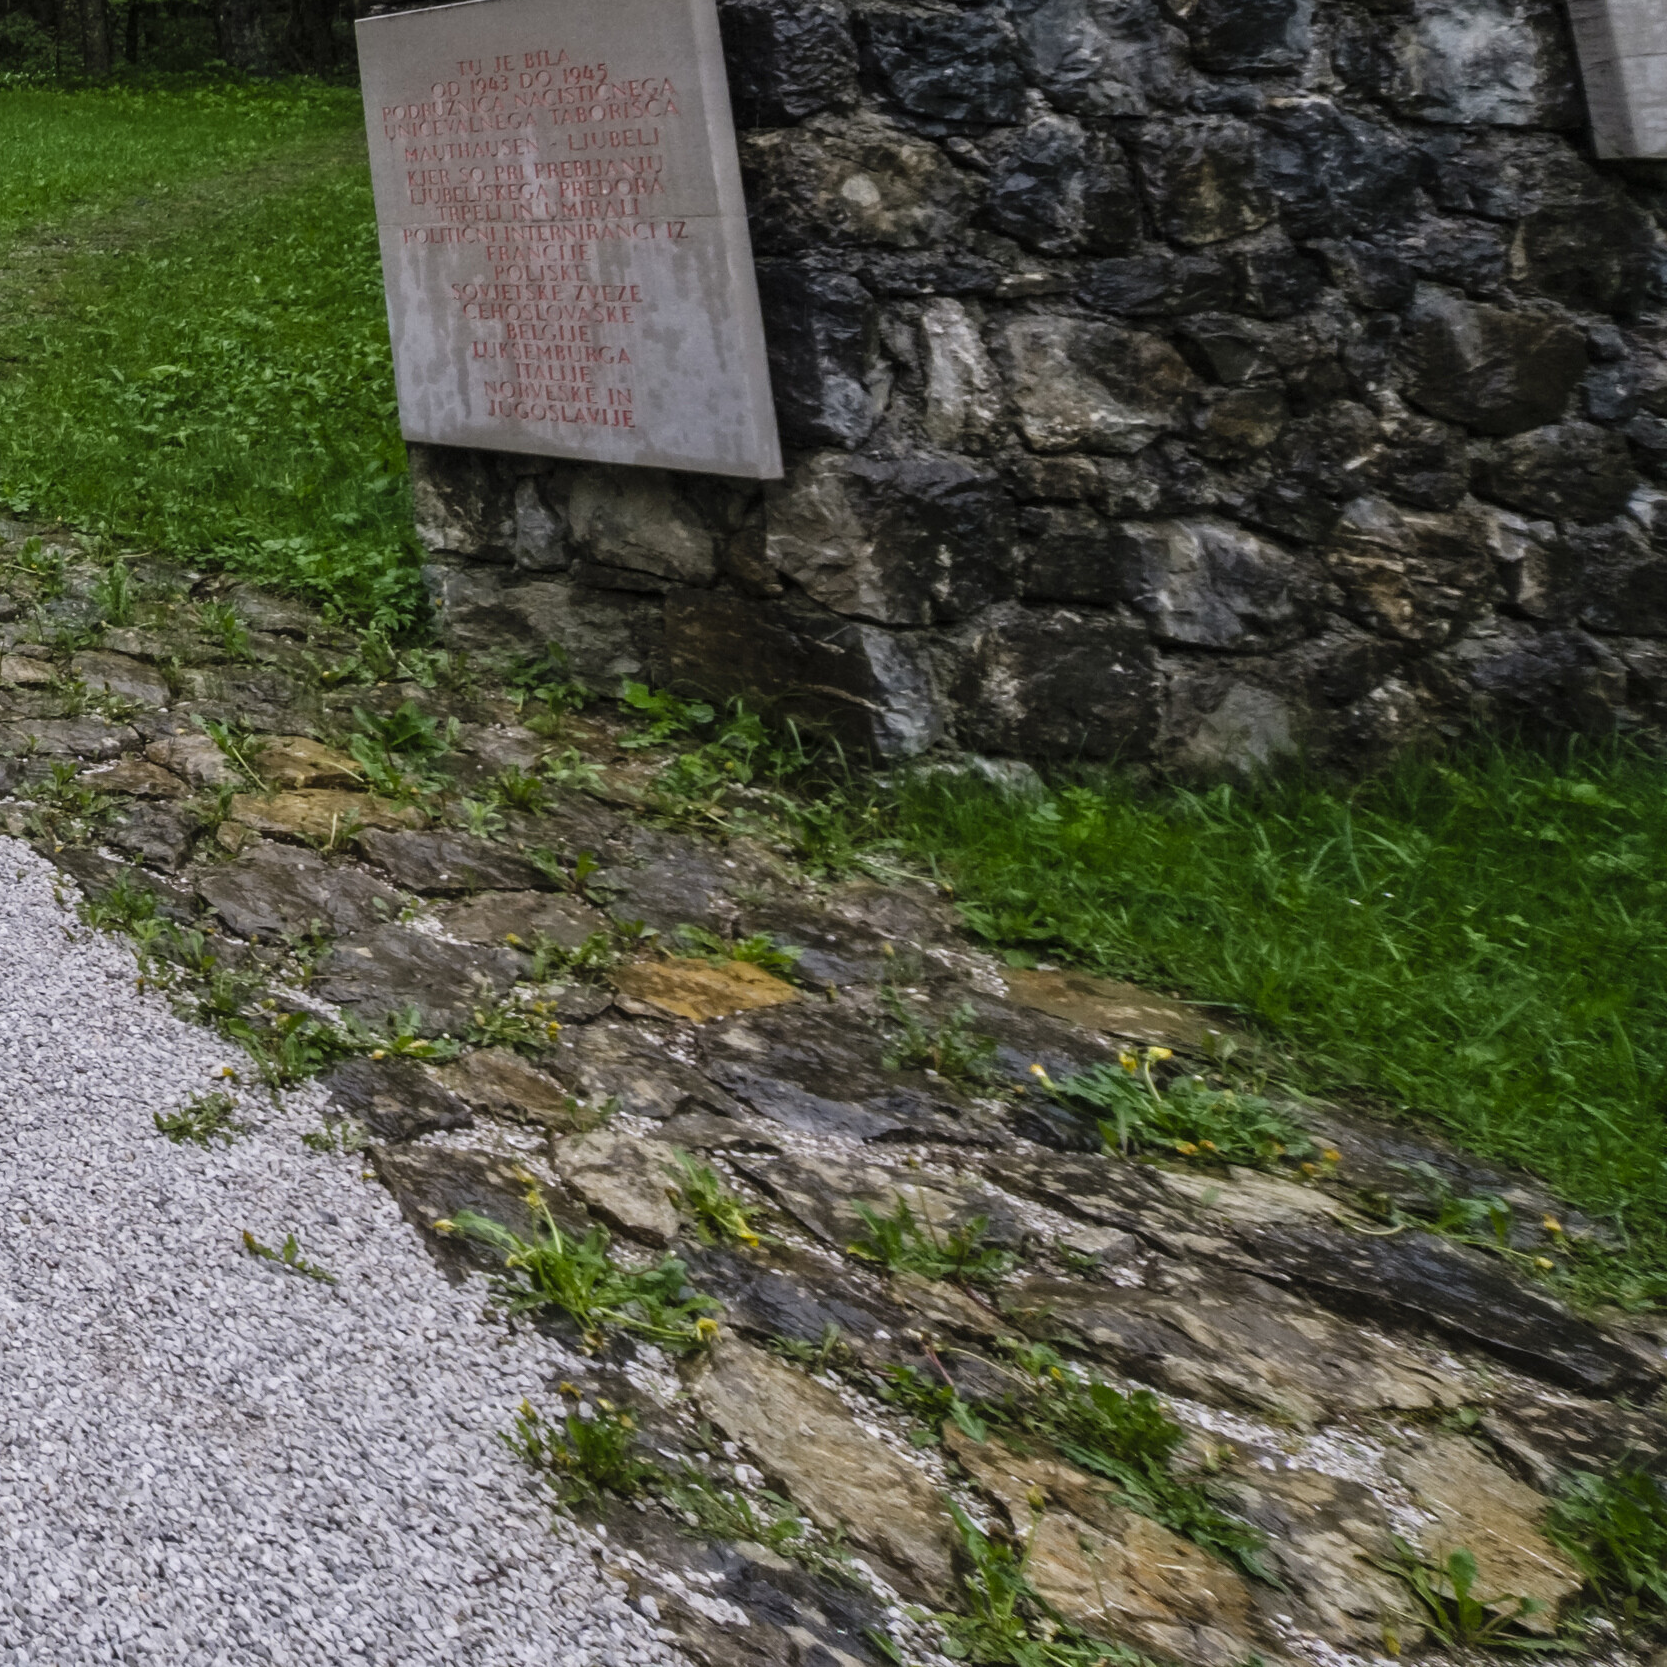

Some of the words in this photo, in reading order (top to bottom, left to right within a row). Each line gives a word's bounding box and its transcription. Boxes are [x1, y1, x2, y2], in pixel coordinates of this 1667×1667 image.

[457, 59, 482, 76] TU
[492, 55, 514, 72] JE
[524, 48, 569, 68] BILA
[430, 81, 460, 97] OD
[470, 75, 508, 93] 1943
[519, 70, 550, 88] DO
[563, 63, 608, 83] 1945
[404, 138, 539, 161] MAUTHAUSEN
[568, 128, 659, 150] LJUBELJ
[407, 170, 449, 185] KJER
[459, 167, 484, 183] SO
[495, 165, 523, 181] PRI
[534, 156, 664, 179] PREBIJANJU
[410, 183, 547, 204] LJUBELJSKEGA
[559, 177, 665, 198] PREDORA
[437, 205, 503, 221] TRPELI
[512, 203, 532, 218] IN
[545, 199, 640, 217] UMIRALI
[504, 222, 656, 241] INTERNIRANCI
[666, 221, 689, 238] IZ
[486, 245, 591, 260] FRANCIJE
[495, 265, 587, 280] POLJSKE
[451, 284, 563, 300] SOVJETSKE
[573, 285, 643, 301] ZVEZE
[506, 323, 590, 341] BELGIJE
[471, 342, 630, 364] LUKSEMBURGA
[516, 363, 592, 382] ITALIJE
[608, 388, 632, 405] IN
[487, 402, 635, 427] JUGOSLAVIJE
